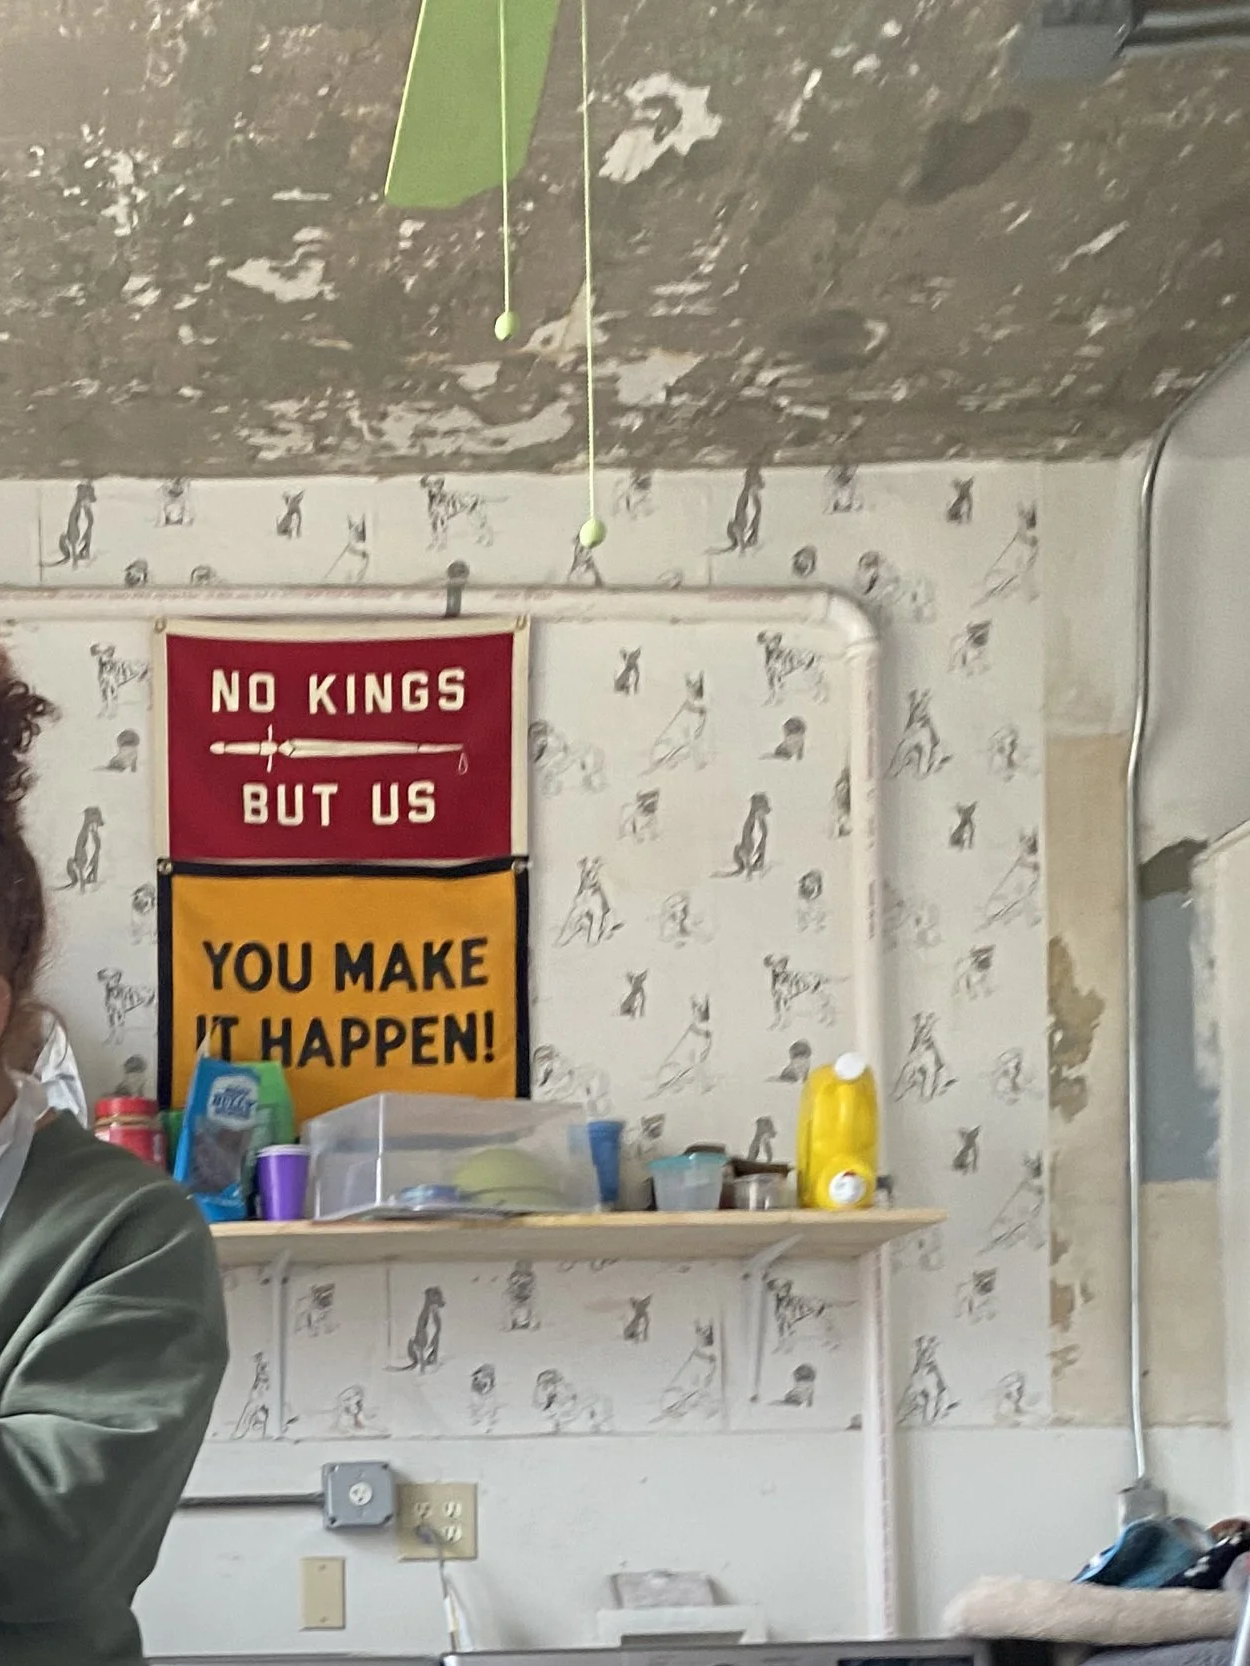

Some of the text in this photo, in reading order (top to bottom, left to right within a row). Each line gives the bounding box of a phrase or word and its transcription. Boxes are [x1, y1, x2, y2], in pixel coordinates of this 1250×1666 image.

[212, 667, 466, 715] NO KINGS
[243, 781, 436, 827] BUT US
[203, 937, 489, 993] YOU MAKE
[196, 1010, 496, 1068] IT HAPPEN!
